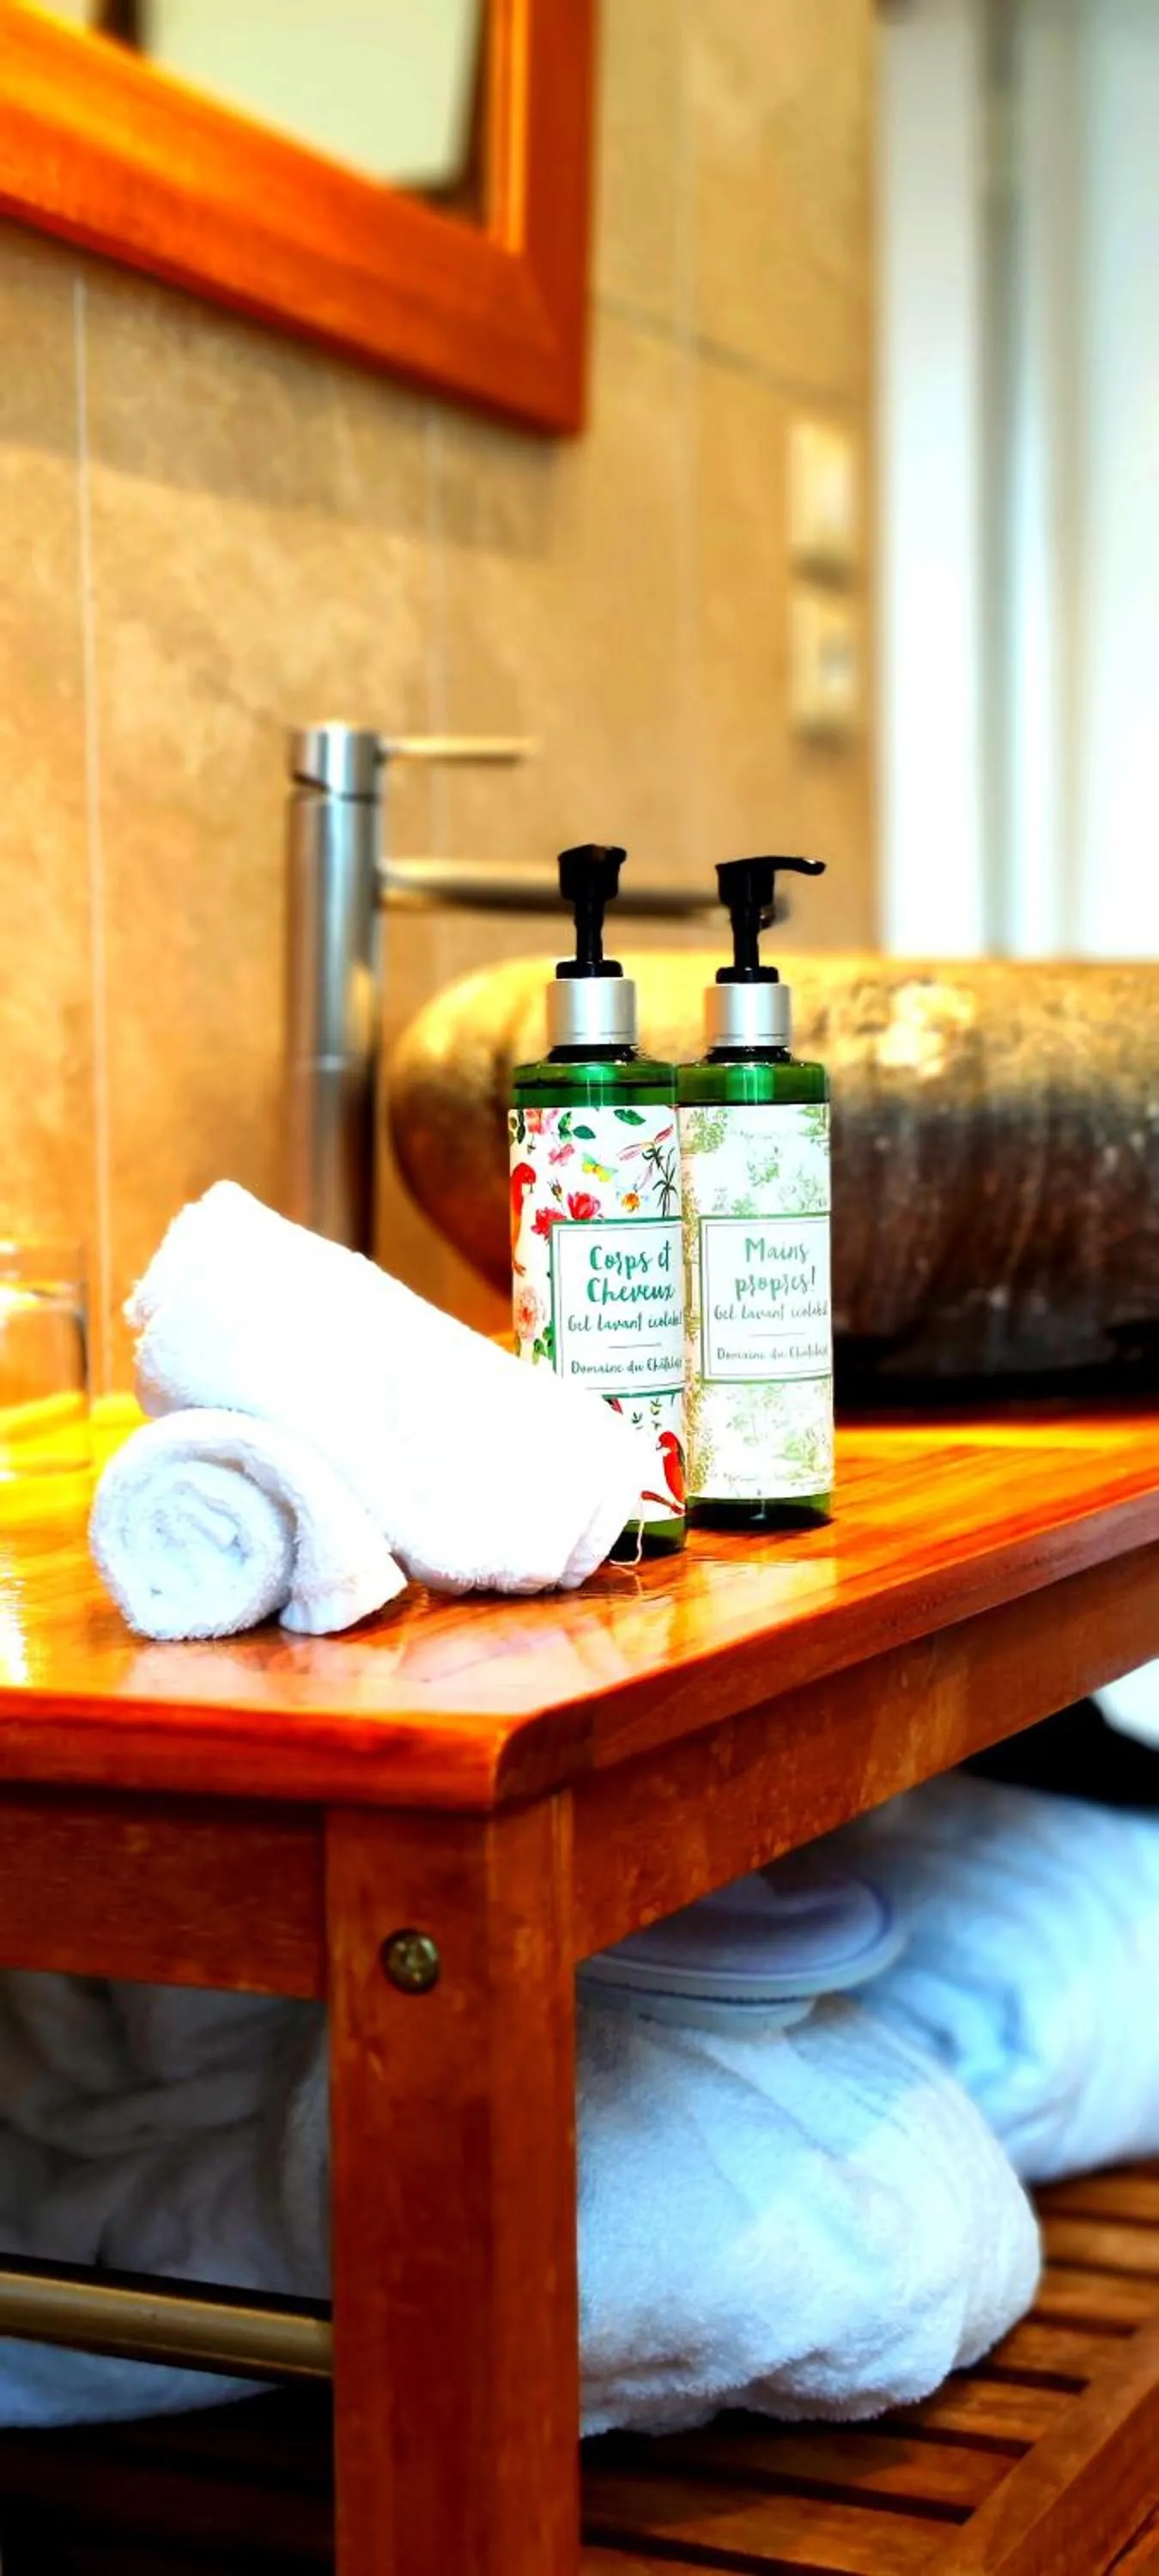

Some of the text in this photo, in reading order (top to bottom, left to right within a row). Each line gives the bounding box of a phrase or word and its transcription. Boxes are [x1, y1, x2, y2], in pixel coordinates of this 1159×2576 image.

[590, 1240, 672, 1279] Corps et
[745, 1236, 810, 1265] Mains
[586, 1277, 676, 1305] Cheveux
[735, 1265, 816, 1301] propres!
[567, 1314, 592, 1331] Gel
[714, 1304, 737, 1321] Gel
[571, 1359, 624, 1375] Domaine
[627, 1359, 645, 1374] du
